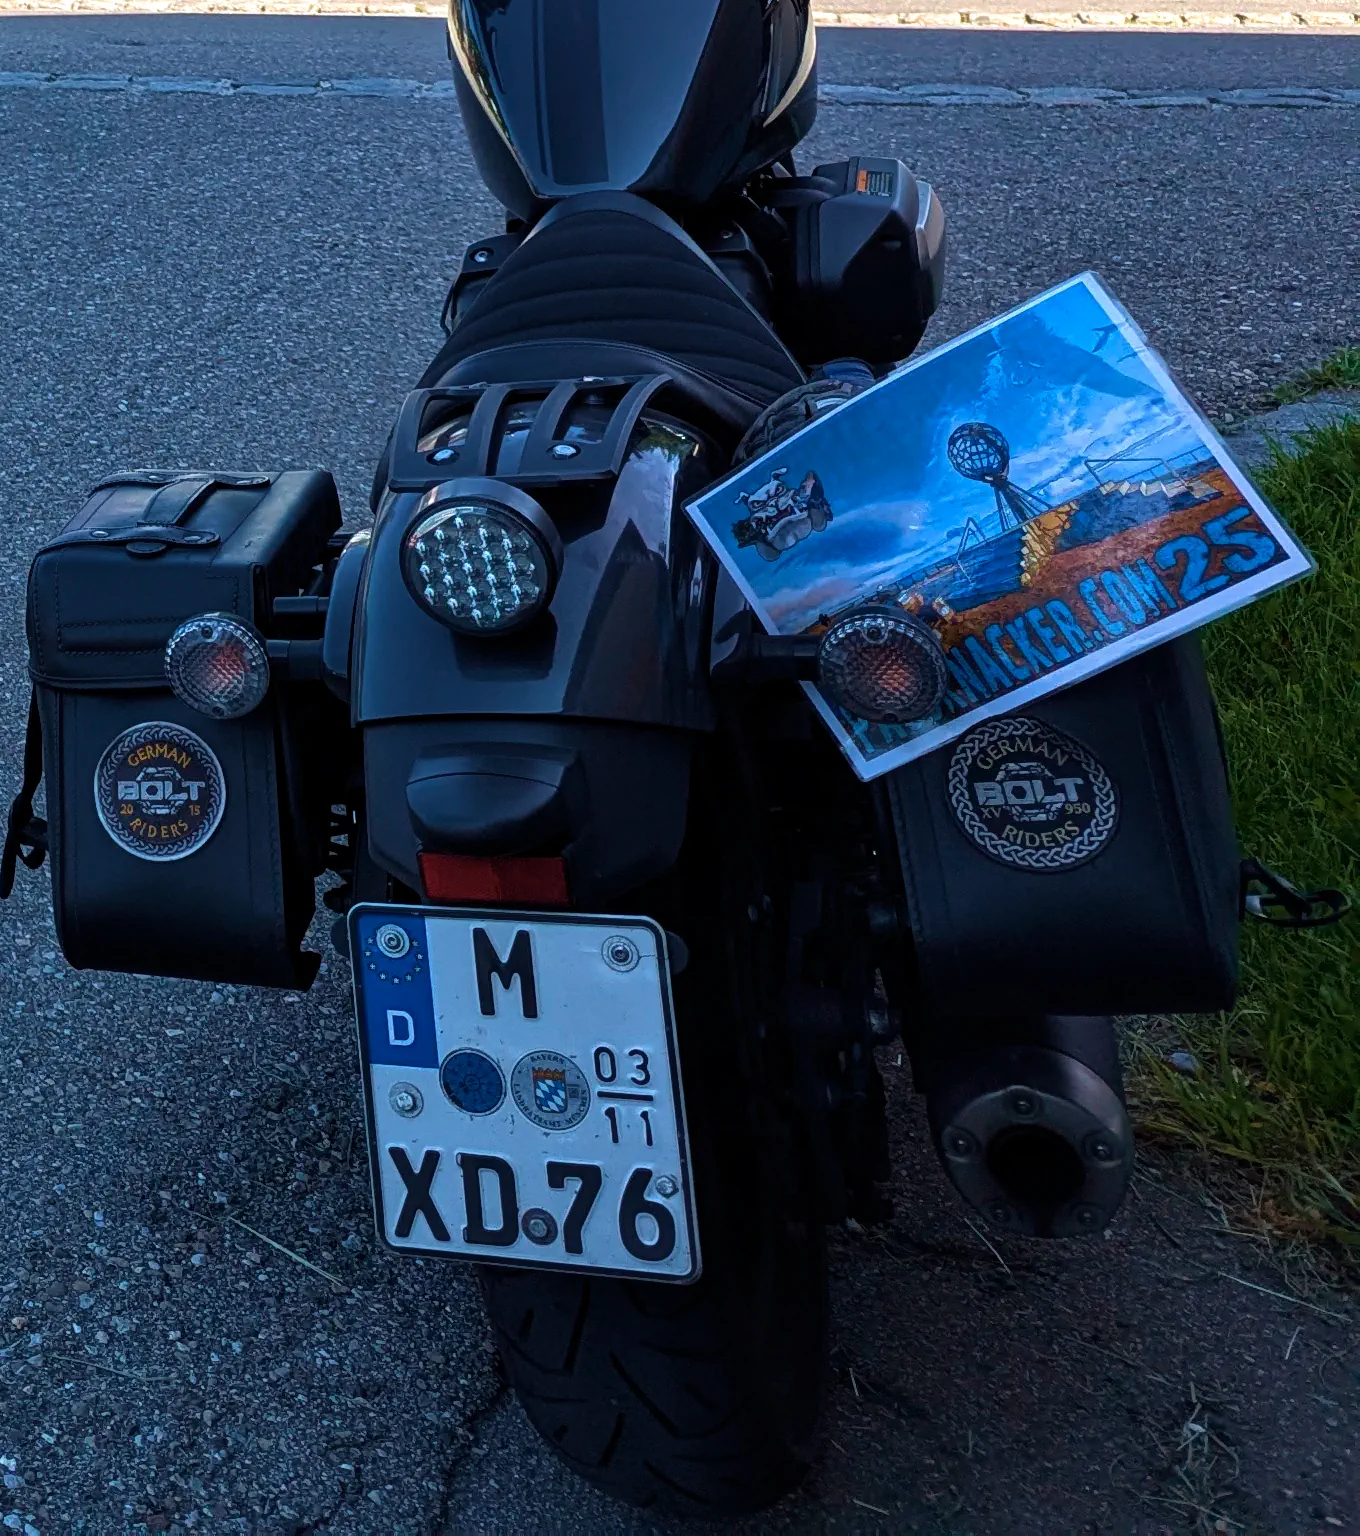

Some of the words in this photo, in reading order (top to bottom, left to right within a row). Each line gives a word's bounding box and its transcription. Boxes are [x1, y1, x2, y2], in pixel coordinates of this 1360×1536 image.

[127, 743, 192, 768] GERMAN
[976, 737, 1069, 770] GERMAN
[118, 780, 205, 801] BOLT
[974, 777, 1084, 806] BOLT
[120, 803, 134, 815] 20
[189, 805, 200, 816] 15
[980, 807, 1002, 820] XV
[1065, 802, 1091, 814] 950
[130, 818, 188, 839] RIDERS
[1001, 820, 1080, 847] RIDERS
[472, 927, 539, 1019] M
[386, 1009, 415, 1046] D
[593, 1045, 651, 1086] 03
[603, 1106, 653, 1147] 11
[387, 1146, 520, 1246] XD
[546, 1160, 676, 1262] 76
